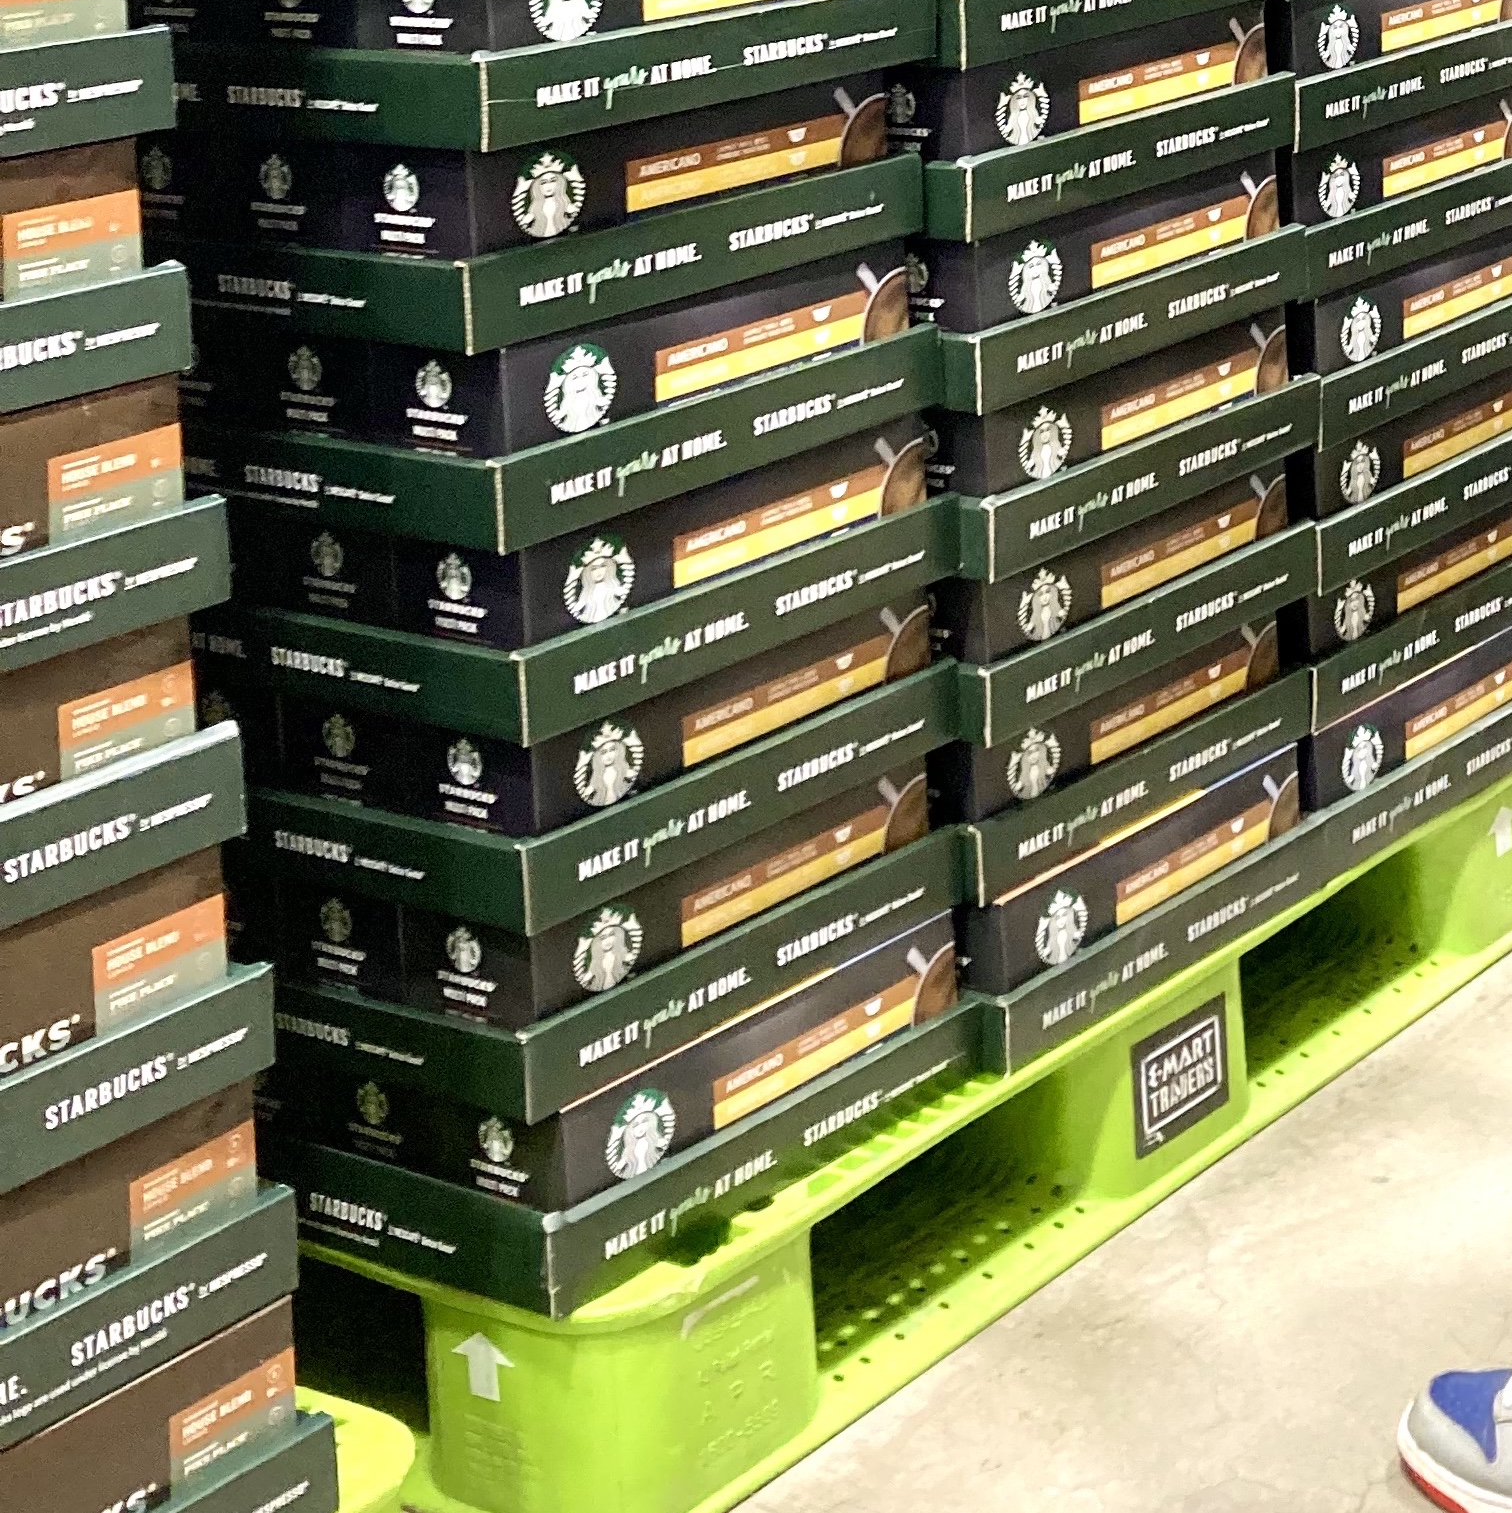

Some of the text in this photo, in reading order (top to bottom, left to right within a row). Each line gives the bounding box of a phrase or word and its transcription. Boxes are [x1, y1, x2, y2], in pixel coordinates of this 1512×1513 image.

[537, 80, 581, 107] MAKE
[584, 77, 600, 98] IT
[650, 63, 668, 86] AT
[671, 54, 716, 82] HOME.
[743, 33, 824, 68] STARBUCKS
[639, 153, 701, 178] AMERICANO
[520, 276, 565, 306] MAKE
[567, 272, 583, 294] IT
[634, 254, 653, 277] AT
[655, 242, 702, 271] HOME.
[729, 213, 811, 251] STARBUCKS
[574, 661, 616, 694] MAKE
[619, 654, 635, 677] IT
[684, 627, 702, 653] AT
[704, 611, 749, 644] HOME.
[776, 570, 854, 616] STARBUCKS
[4, 817, 130, 884] STARBUCKS
[579, 846, 621, 882] MAKE
[624, 838, 639, 863] IT
[687, 808, 705, 833] AT
[708, 789, 751, 823] HOME.
[778, 742, 854, 792] STARBUCKS
[580, 1030, 621, 1067] MAKE
[625, 1020, 639, 1045] IT
[688, 988, 704, 1013] AT
[708, 967, 751, 1002] HOME.
[777, 914, 854, 967] STARBUCKS
[45, 1055, 168, 1130] STARBUCKS
[1150, 1058, 1214, 1117] TRADERS
[310, 1192, 386, 1231] STARBUCKS
[605, 1220, 647, 1260] MAKE
[651, 1209, 666, 1234] IT
[715, 1172, 731, 1198] AT
[735, 1150, 777, 1187] HOME.
[804, 1090, 880, 1147] STARBUCKS
[70, 1285, 190, 1368] STARBUCKS
